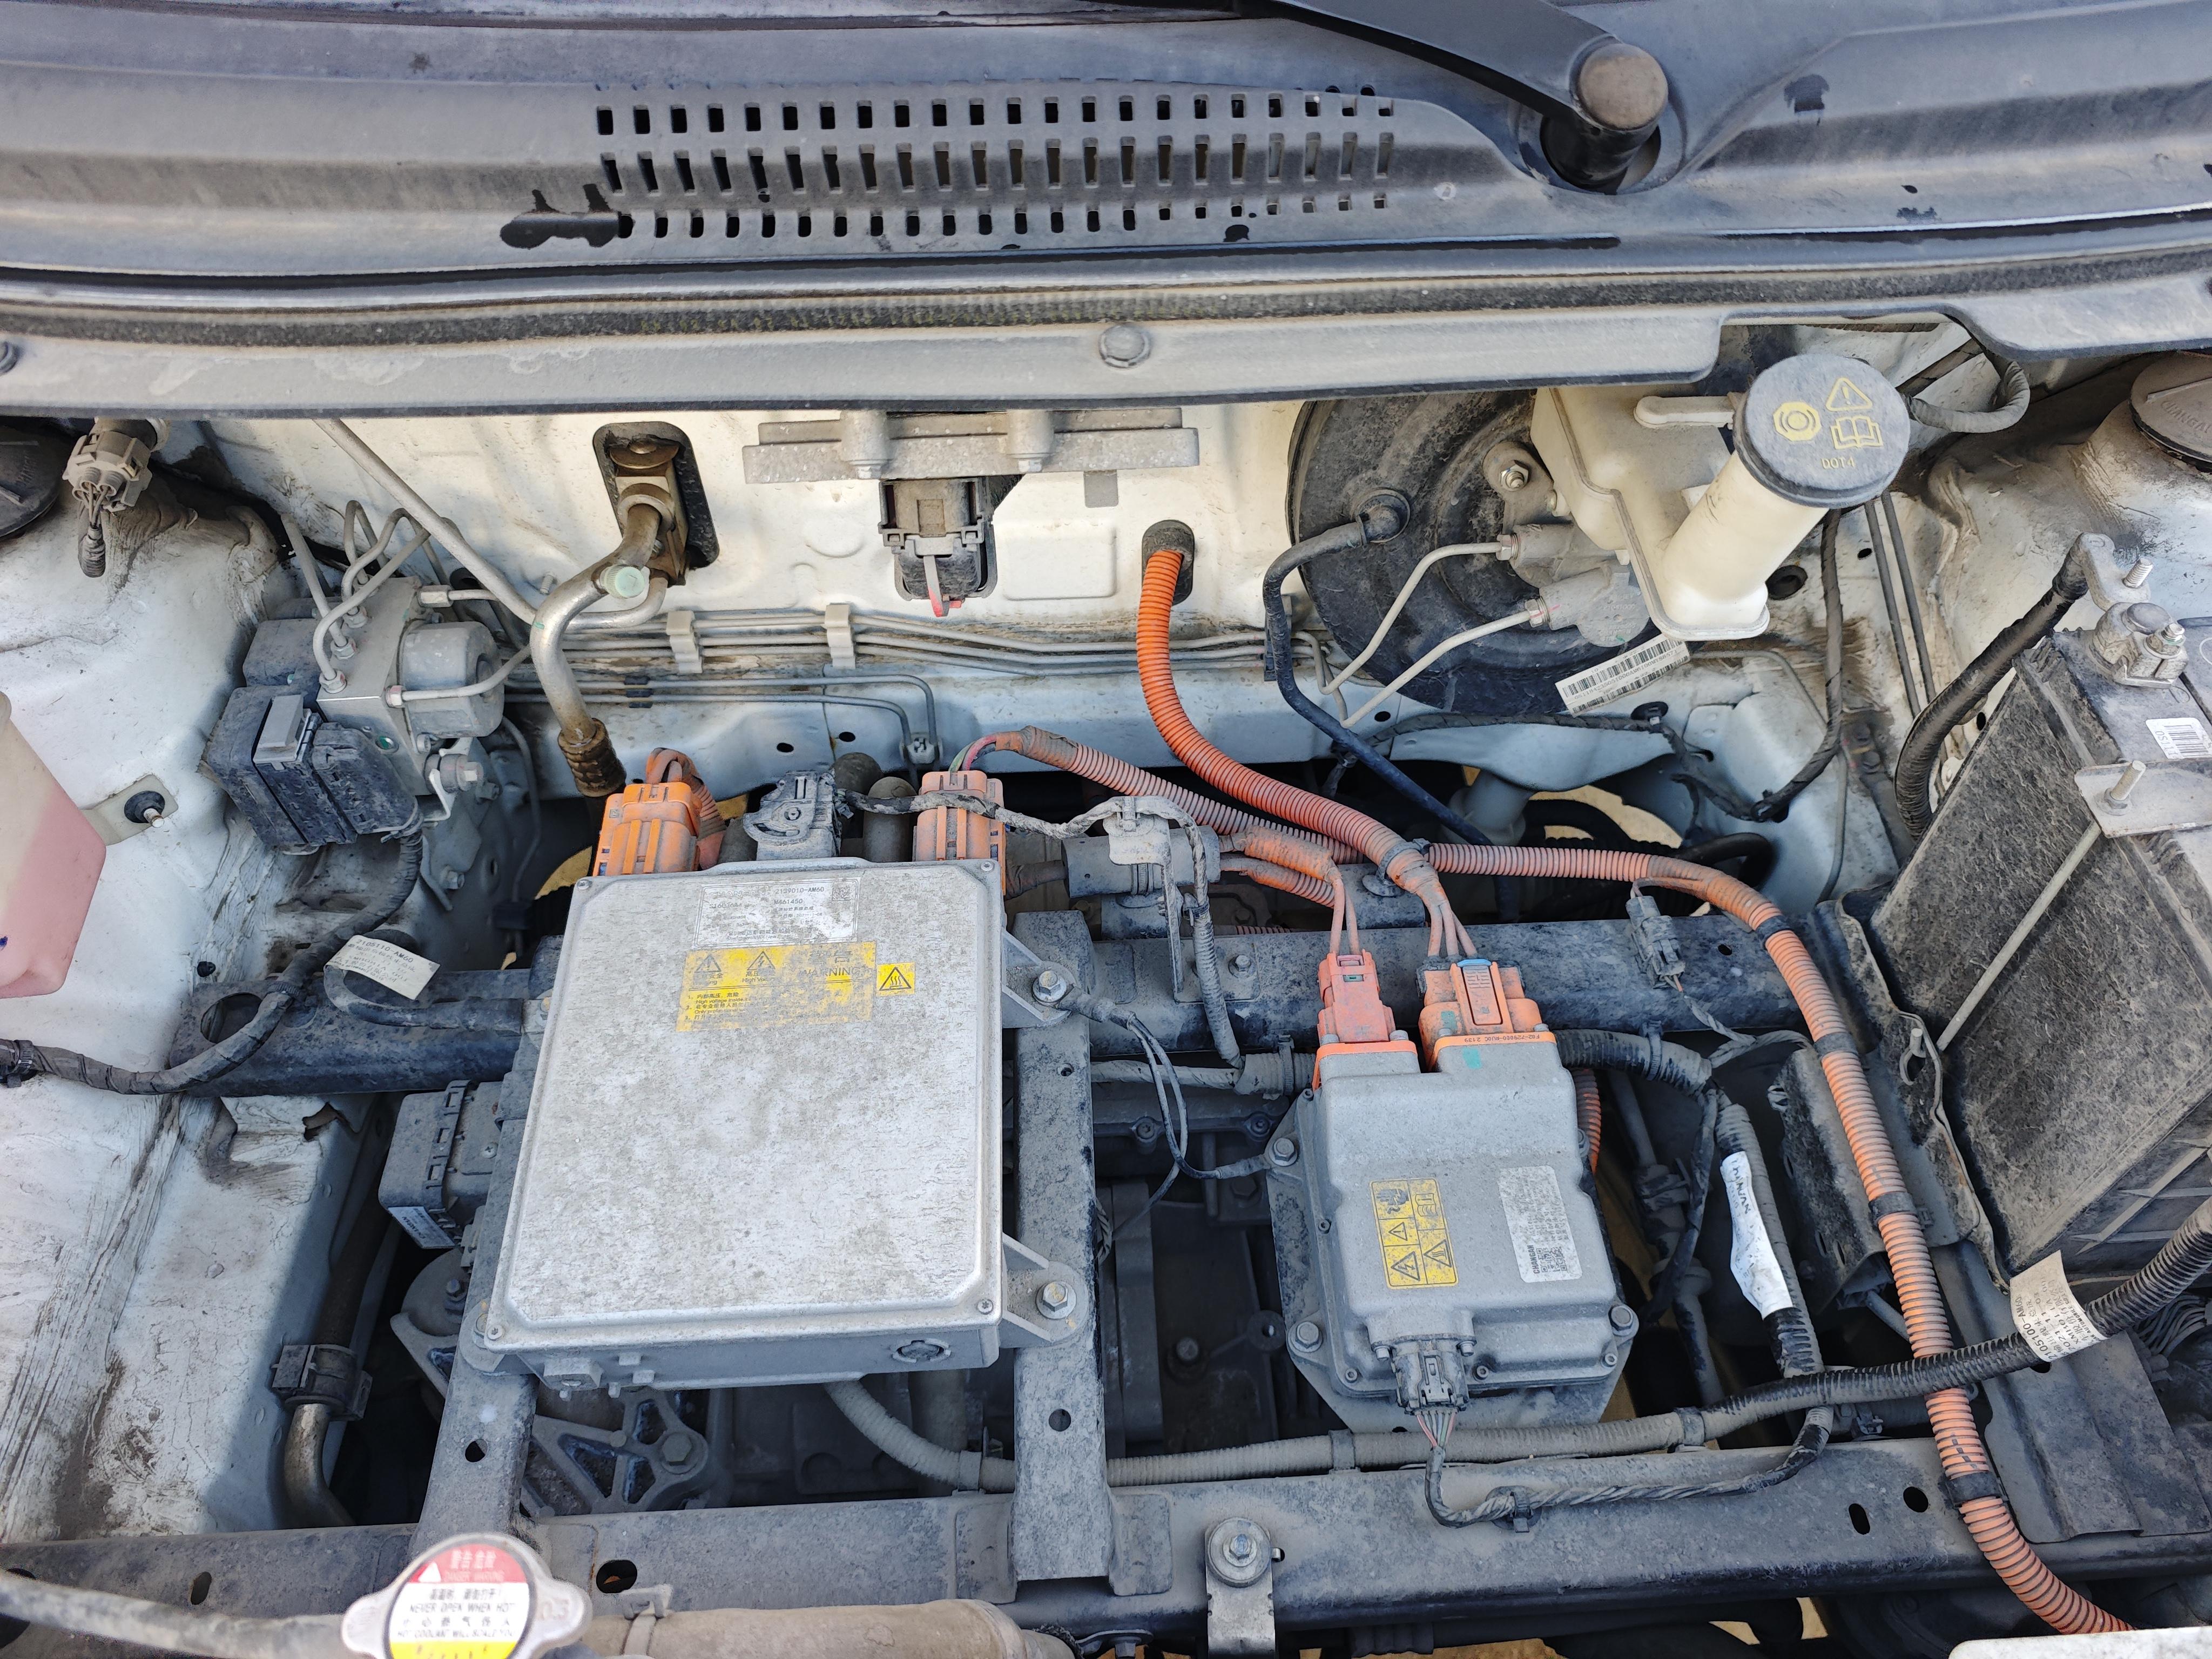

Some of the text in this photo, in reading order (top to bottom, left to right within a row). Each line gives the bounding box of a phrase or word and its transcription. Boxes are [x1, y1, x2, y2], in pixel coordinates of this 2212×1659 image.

[1527, 1245, 1539, 1274] CHANGAN
[409, 1603, 435, 1613] NEVER
[440, 1603, 462, 1613] OPEN
[467, 1603, 493, 1613] WHEN
